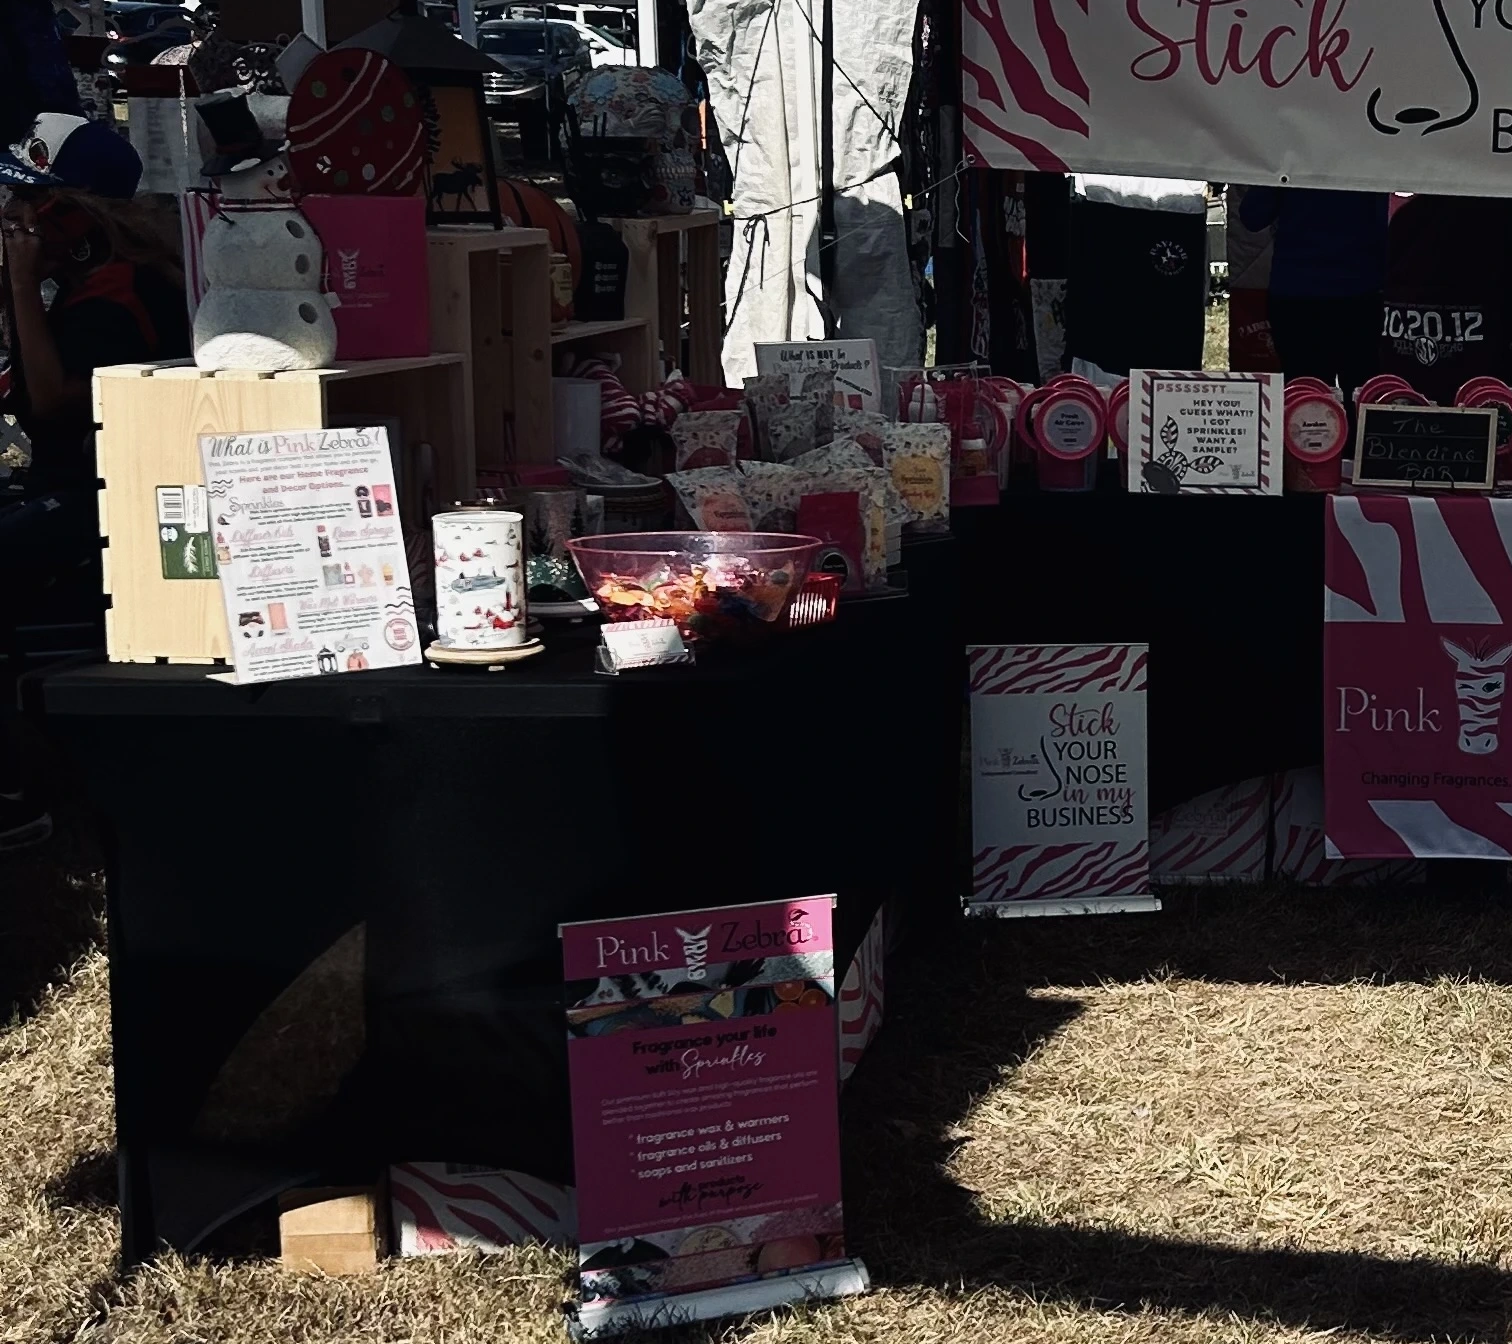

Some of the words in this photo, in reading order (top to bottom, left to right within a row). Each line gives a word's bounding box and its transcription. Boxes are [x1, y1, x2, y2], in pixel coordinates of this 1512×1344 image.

[1193, 399, 1213, 407] HEY
[1392, 416, 1445, 434] The
[209, 435, 252, 458] What
[258, 439, 271, 455] is
[272, 433, 316, 454] Pink
[1049, 701, 1121, 738] Stick
[1335, 685, 1442, 734] Pink
[1053, 740, 1118, 761] YOUR
[1065, 762, 1128, 785] NOSE
[1361, 771, 1431, 789] Changing
[1433, 772, 1512, 788] Fragrances.
[1063, 785, 1089, 804] in
[1096, 787, 1136, 818] my
[1026, 805, 1135, 829] BUSINESS
[595, 931, 671, 969] Pink
[720, 910, 814, 954] Zebra
[632, 1035, 713, 1055] Fragrance
[716, 1028, 750, 1048] your
[753, 1024, 778, 1039] life
[644, 1058, 680, 1075] with
[680, 1044, 767, 1080] Sprinkles
[636, 1127, 695, 1145] fragrance
[697, 1124, 723, 1135] wax
[724, 1119, 735, 1132] &
[737, 1113, 790, 1130] warmers
[637, 1144, 696, 1162] fragrance
[698, 1140, 717, 1154] oils
[719, 1137, 730, 1150] &
[731, 1130, 783, 1148] diffusers
[637, 1166, 673, 1180] soaps
[674, 1159, 698, 1173] and
[699, 1151, 754, 1170] sanitizers
